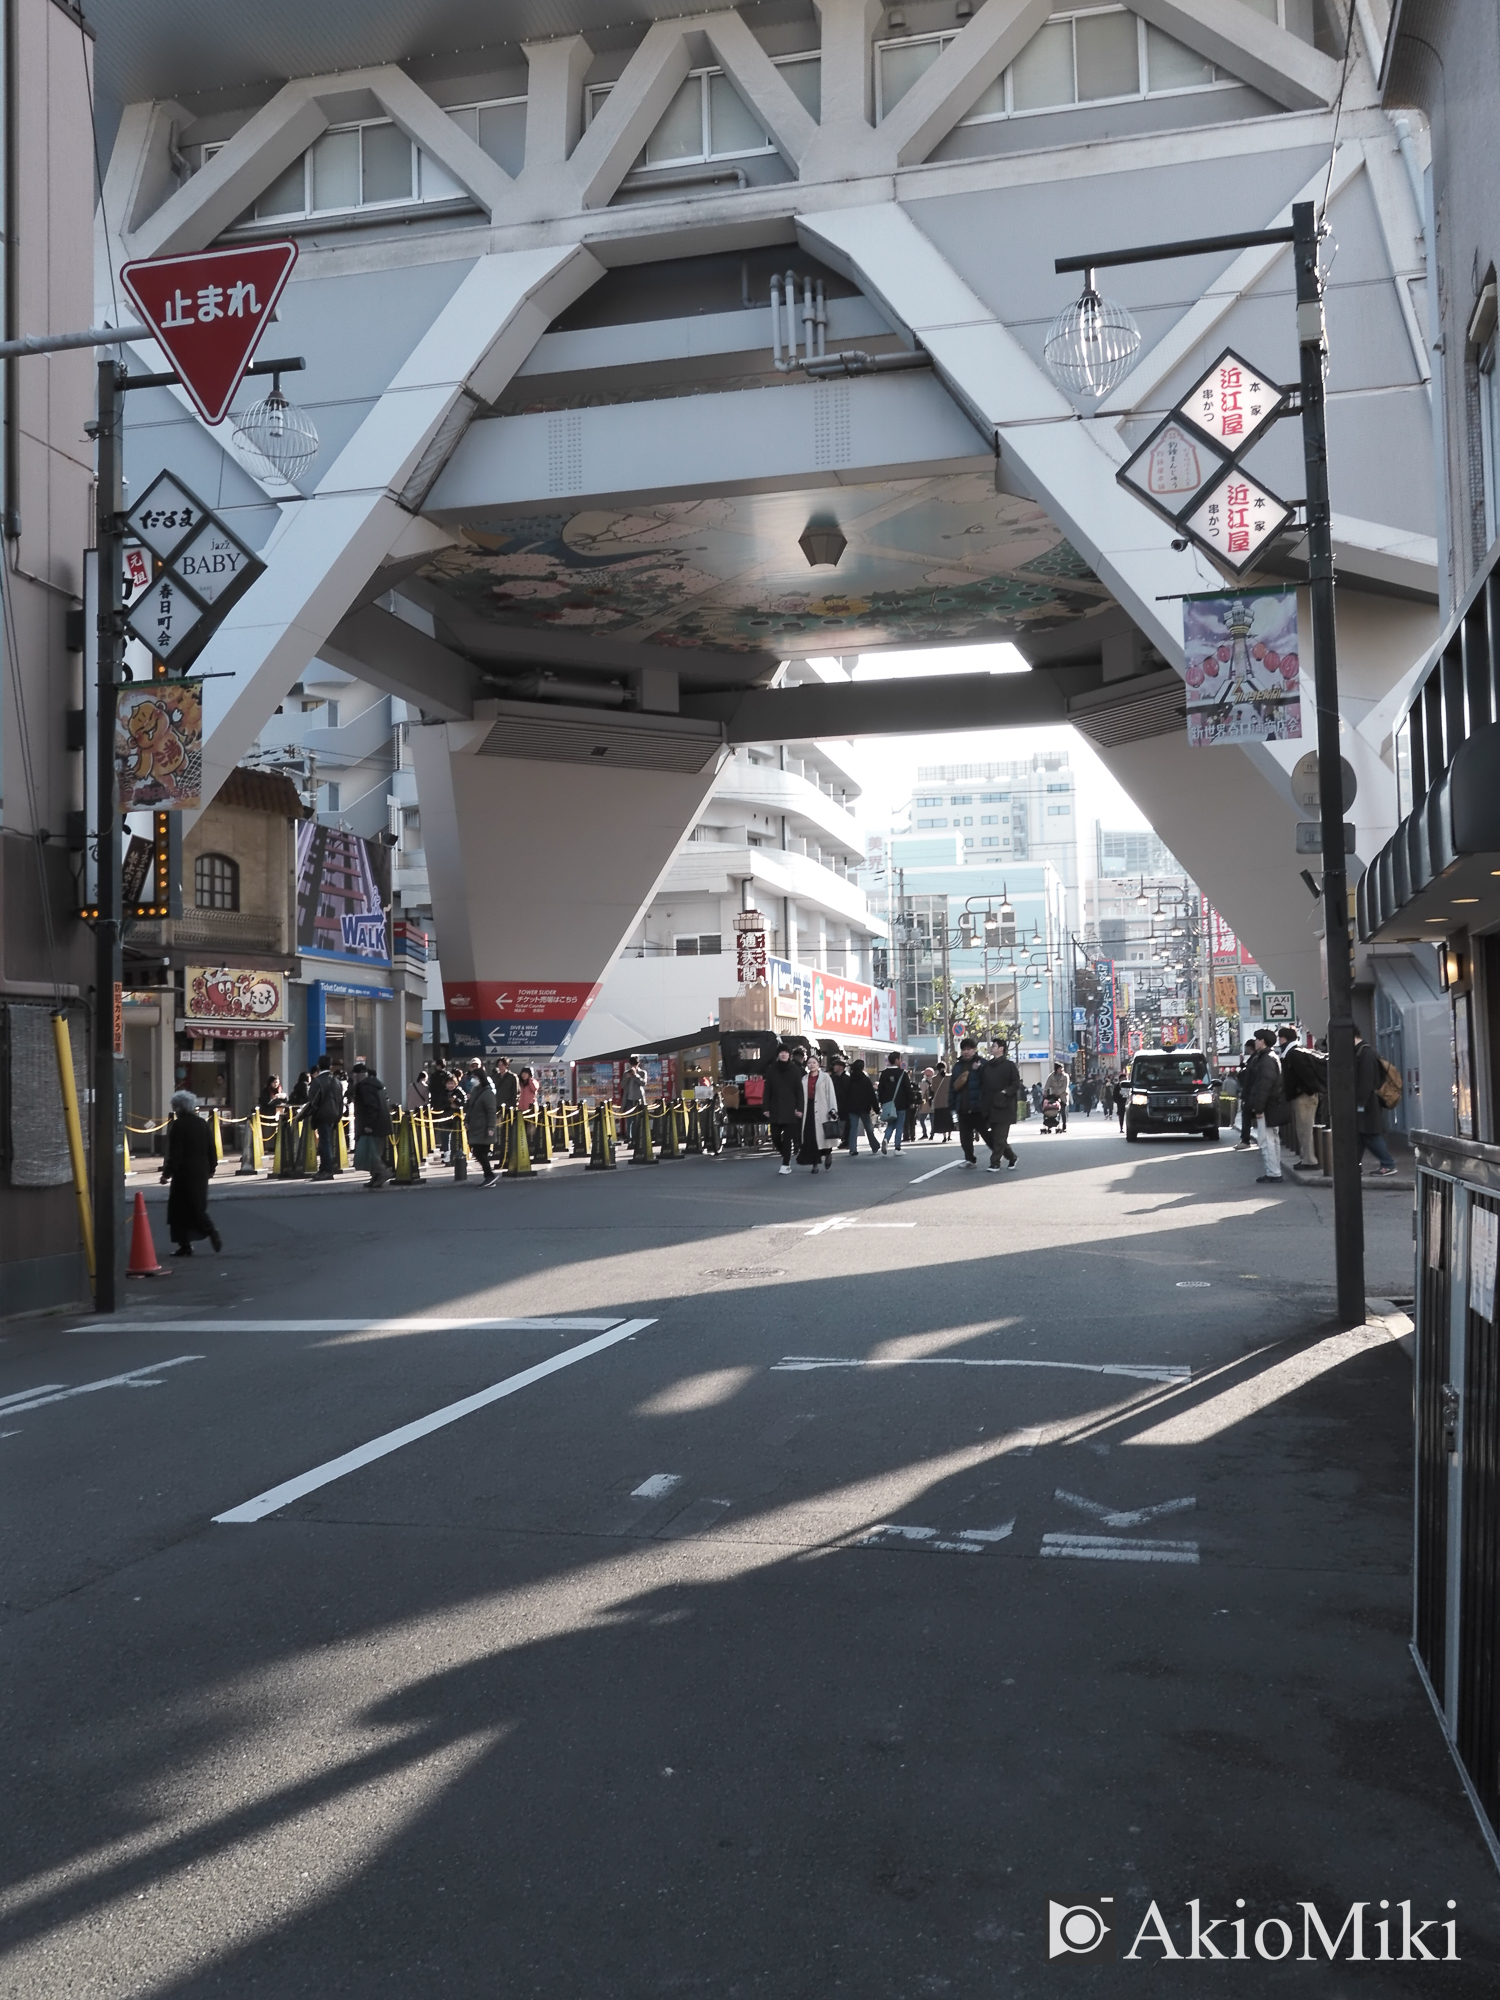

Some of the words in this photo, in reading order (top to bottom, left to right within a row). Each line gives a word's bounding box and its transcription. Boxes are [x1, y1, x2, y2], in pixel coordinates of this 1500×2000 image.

[161, 281, 262, 328] 止まれ
[1203, 389, 1215, 422] 串かつ
[1220, 367, 1244, 436] 近江屋
[139, 508, 194, 529] だるま
[1208, 504, 1220, 537] 串かつ
[1227, 484, 1250, 553] 近江屋
[130, 554, 147, 585] 元祖
[182, 552, 241, 575] BABY
[157, 583, 174, 647] 春日町会
[341, 915, 386, 951] WALK
[739, 933, 757, 981] 通天閣
[250, 990, 273, 1007] たこ天
[320, 982, 333, 991] Ticket
[334, 983, 347, 993] Center
[516, 996, 578, 1004] チケット売場はこちら
